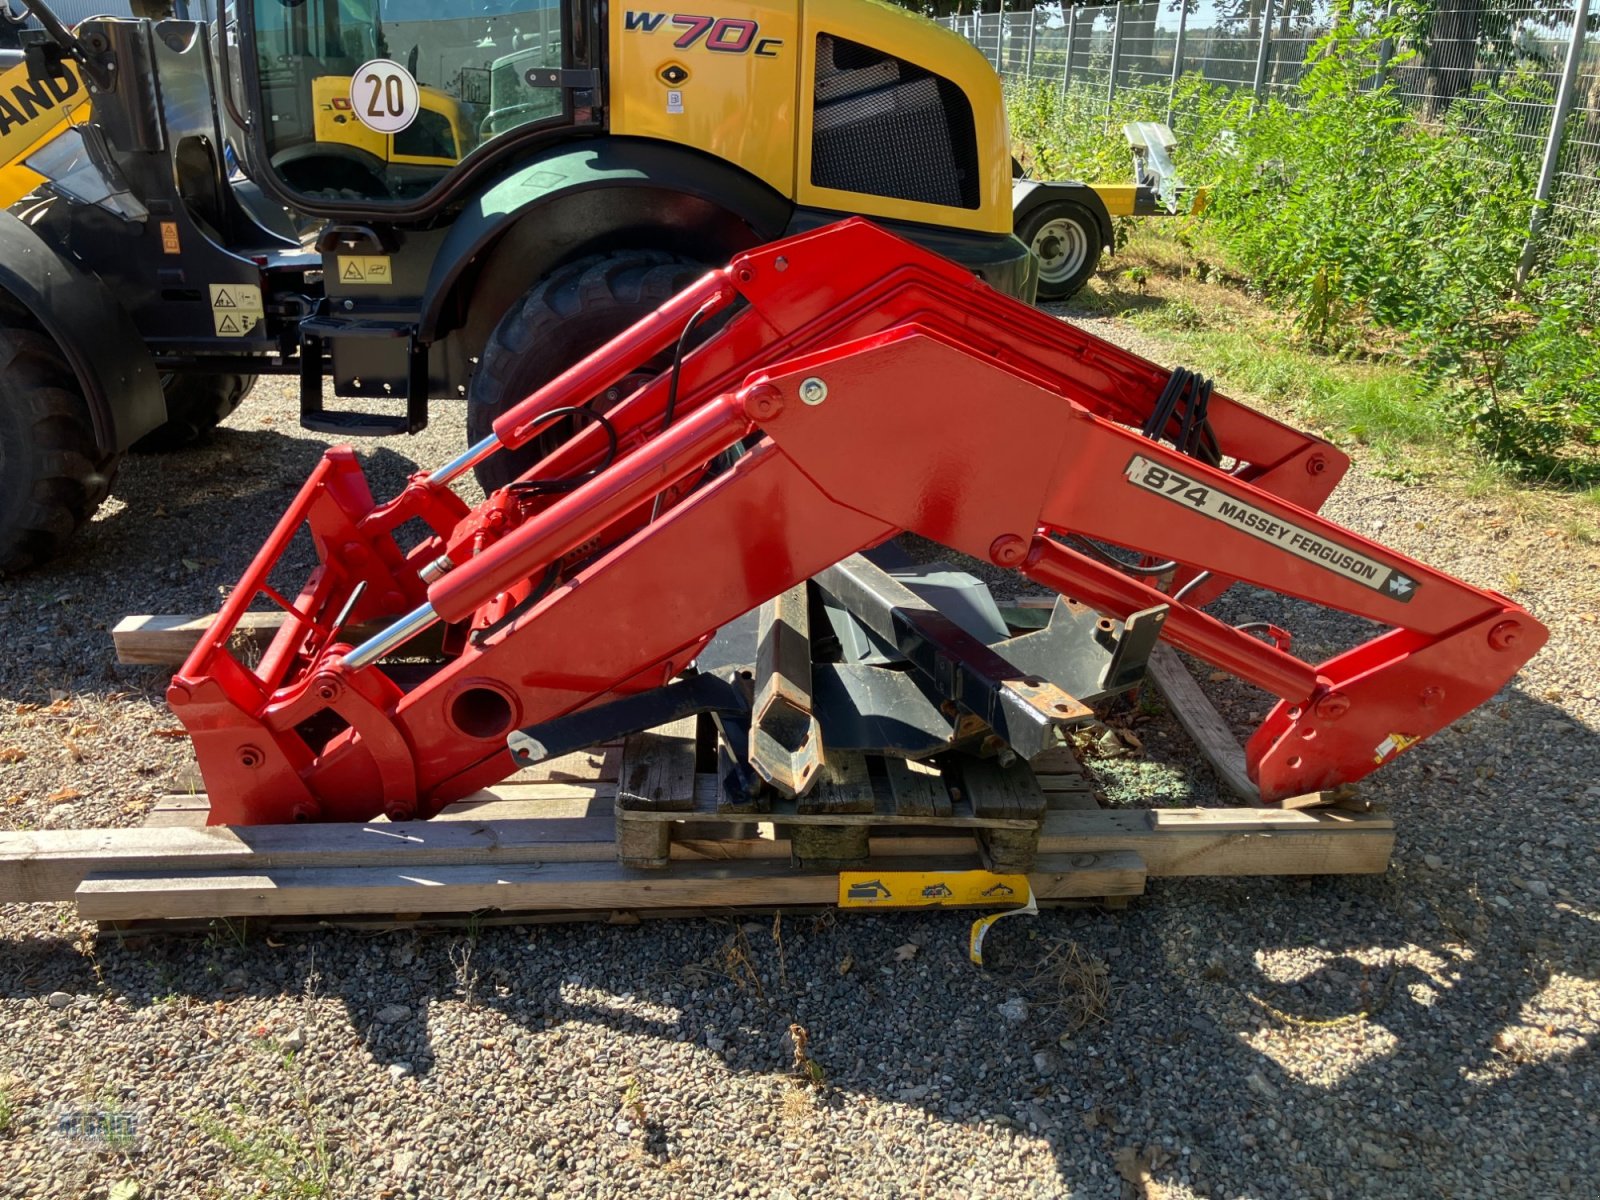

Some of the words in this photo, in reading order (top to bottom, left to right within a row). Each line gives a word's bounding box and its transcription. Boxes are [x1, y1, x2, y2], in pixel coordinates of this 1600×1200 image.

[364, 73, 404, 117] 20
[1142, 466, 1210, 508] 874
[1217, 501, 1293, 541] MASSEY
[1289, 533, 1379, 581] FERGUSON
